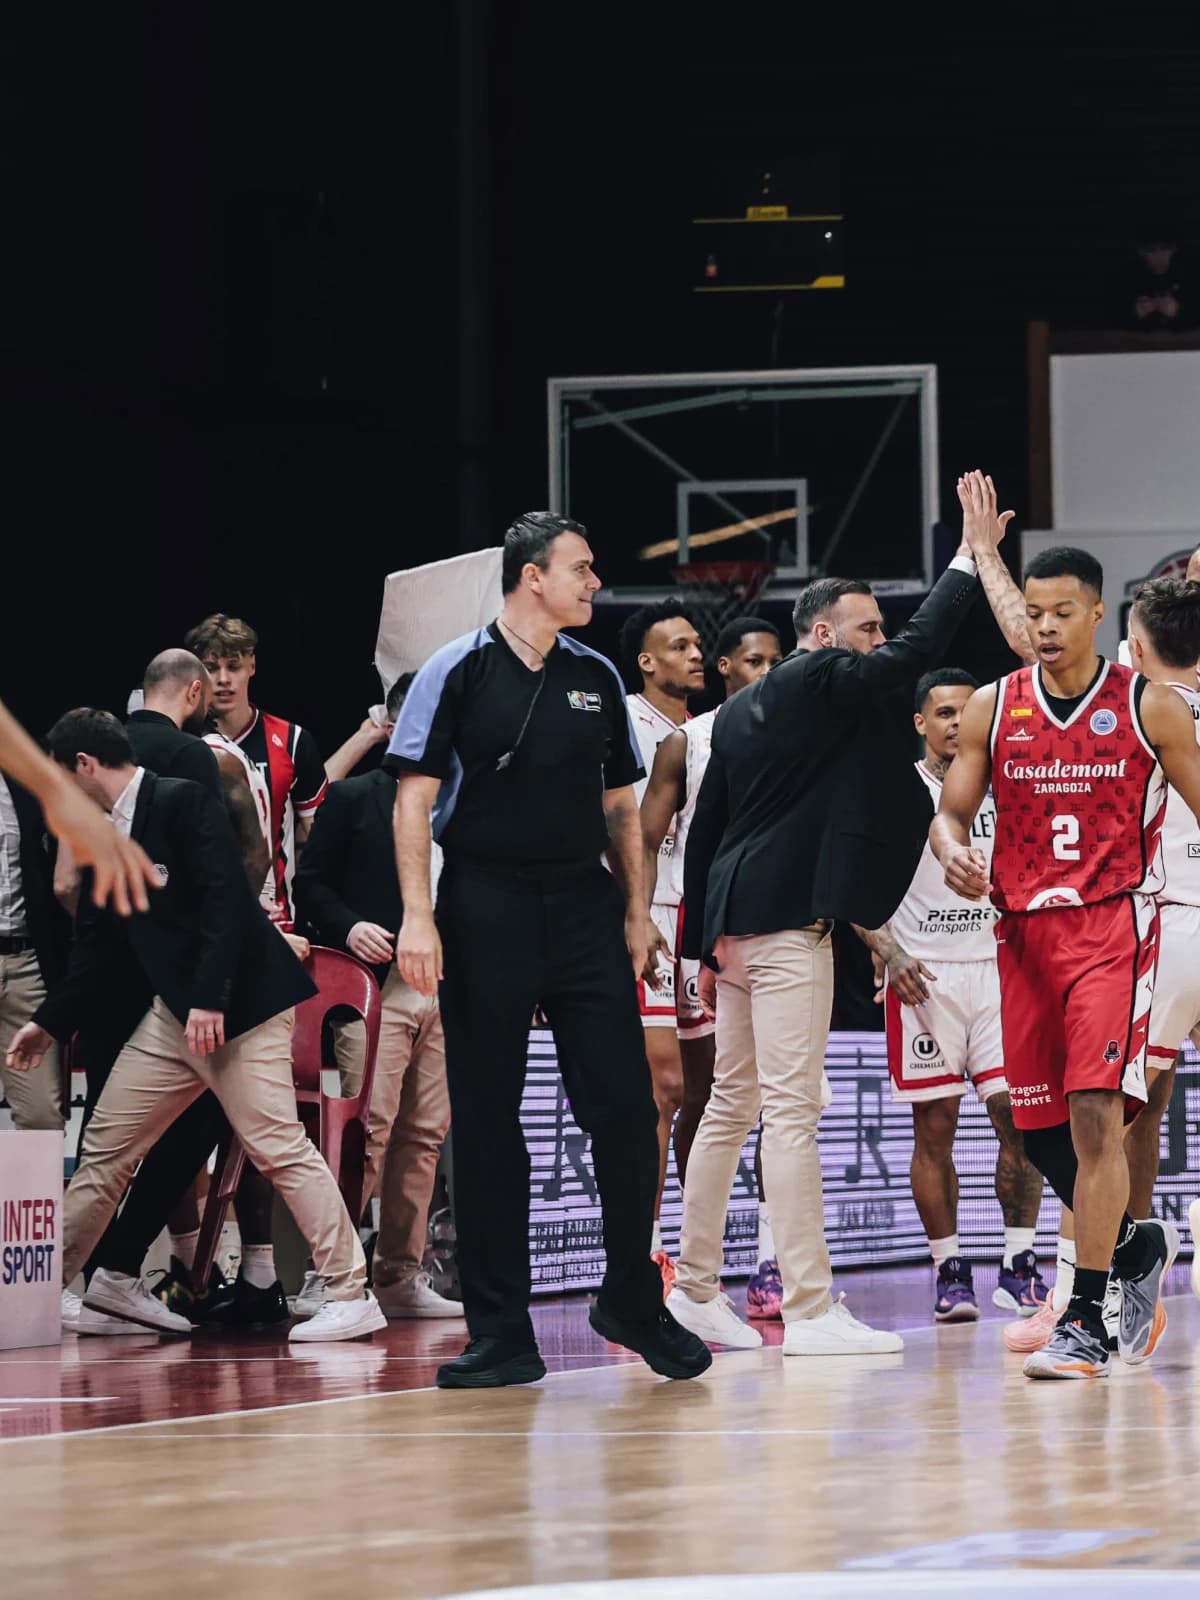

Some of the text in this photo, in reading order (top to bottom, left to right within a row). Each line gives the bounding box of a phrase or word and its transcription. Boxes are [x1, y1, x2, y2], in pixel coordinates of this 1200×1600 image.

[1003, 758, 1127, 780] Casademont
[1034, 782, 1092, 794] ZARAGOZA
[1051, 814, 1081, 860] 2
[918, 920, 982, 935] Transports
[4, 1199, 55, 1242] INTER
[3, 1244, 55, 1285] SPORT
